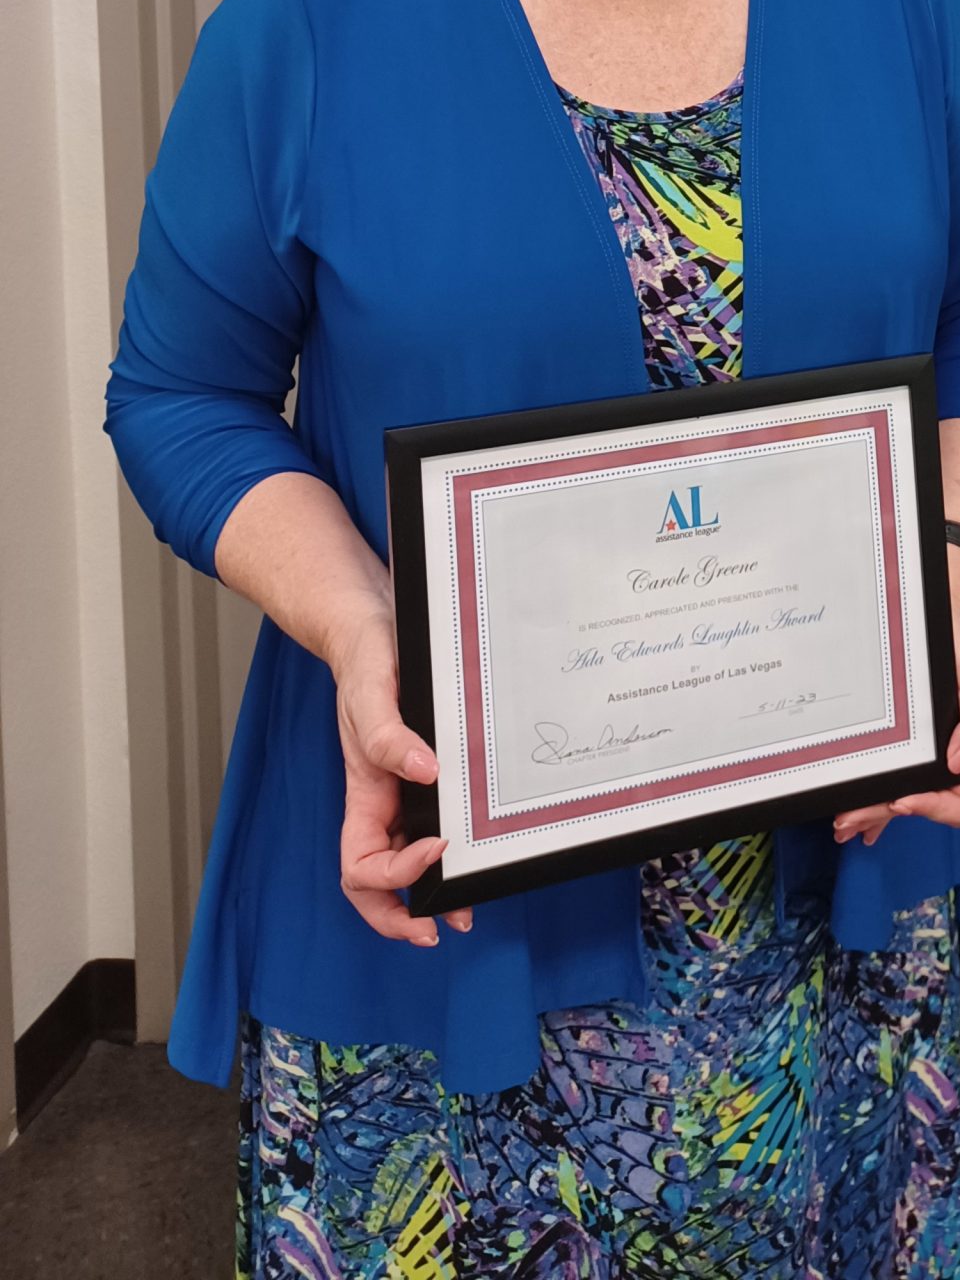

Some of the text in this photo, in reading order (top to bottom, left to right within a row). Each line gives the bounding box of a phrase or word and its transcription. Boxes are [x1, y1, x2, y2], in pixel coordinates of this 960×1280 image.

[656, 485, 719, 535] AL
[655, 531, 693, 544] assistance
[626, 555, 759, 594] Carole Greene
[578, 624, 587, 633] IS
[644, 602, 699, 620] APPRECIATED
[699, 598, 717, 609] AND
[717, 590, 763, 606] PRESENTED
[764, 586, 784, 597] WITH
[785, 583, 800, 592] THE
[560, 604, 827, 673] Ada Edwards Laughlin Award
[606, 657, 783, 704] Assistance League of Las Vegas
